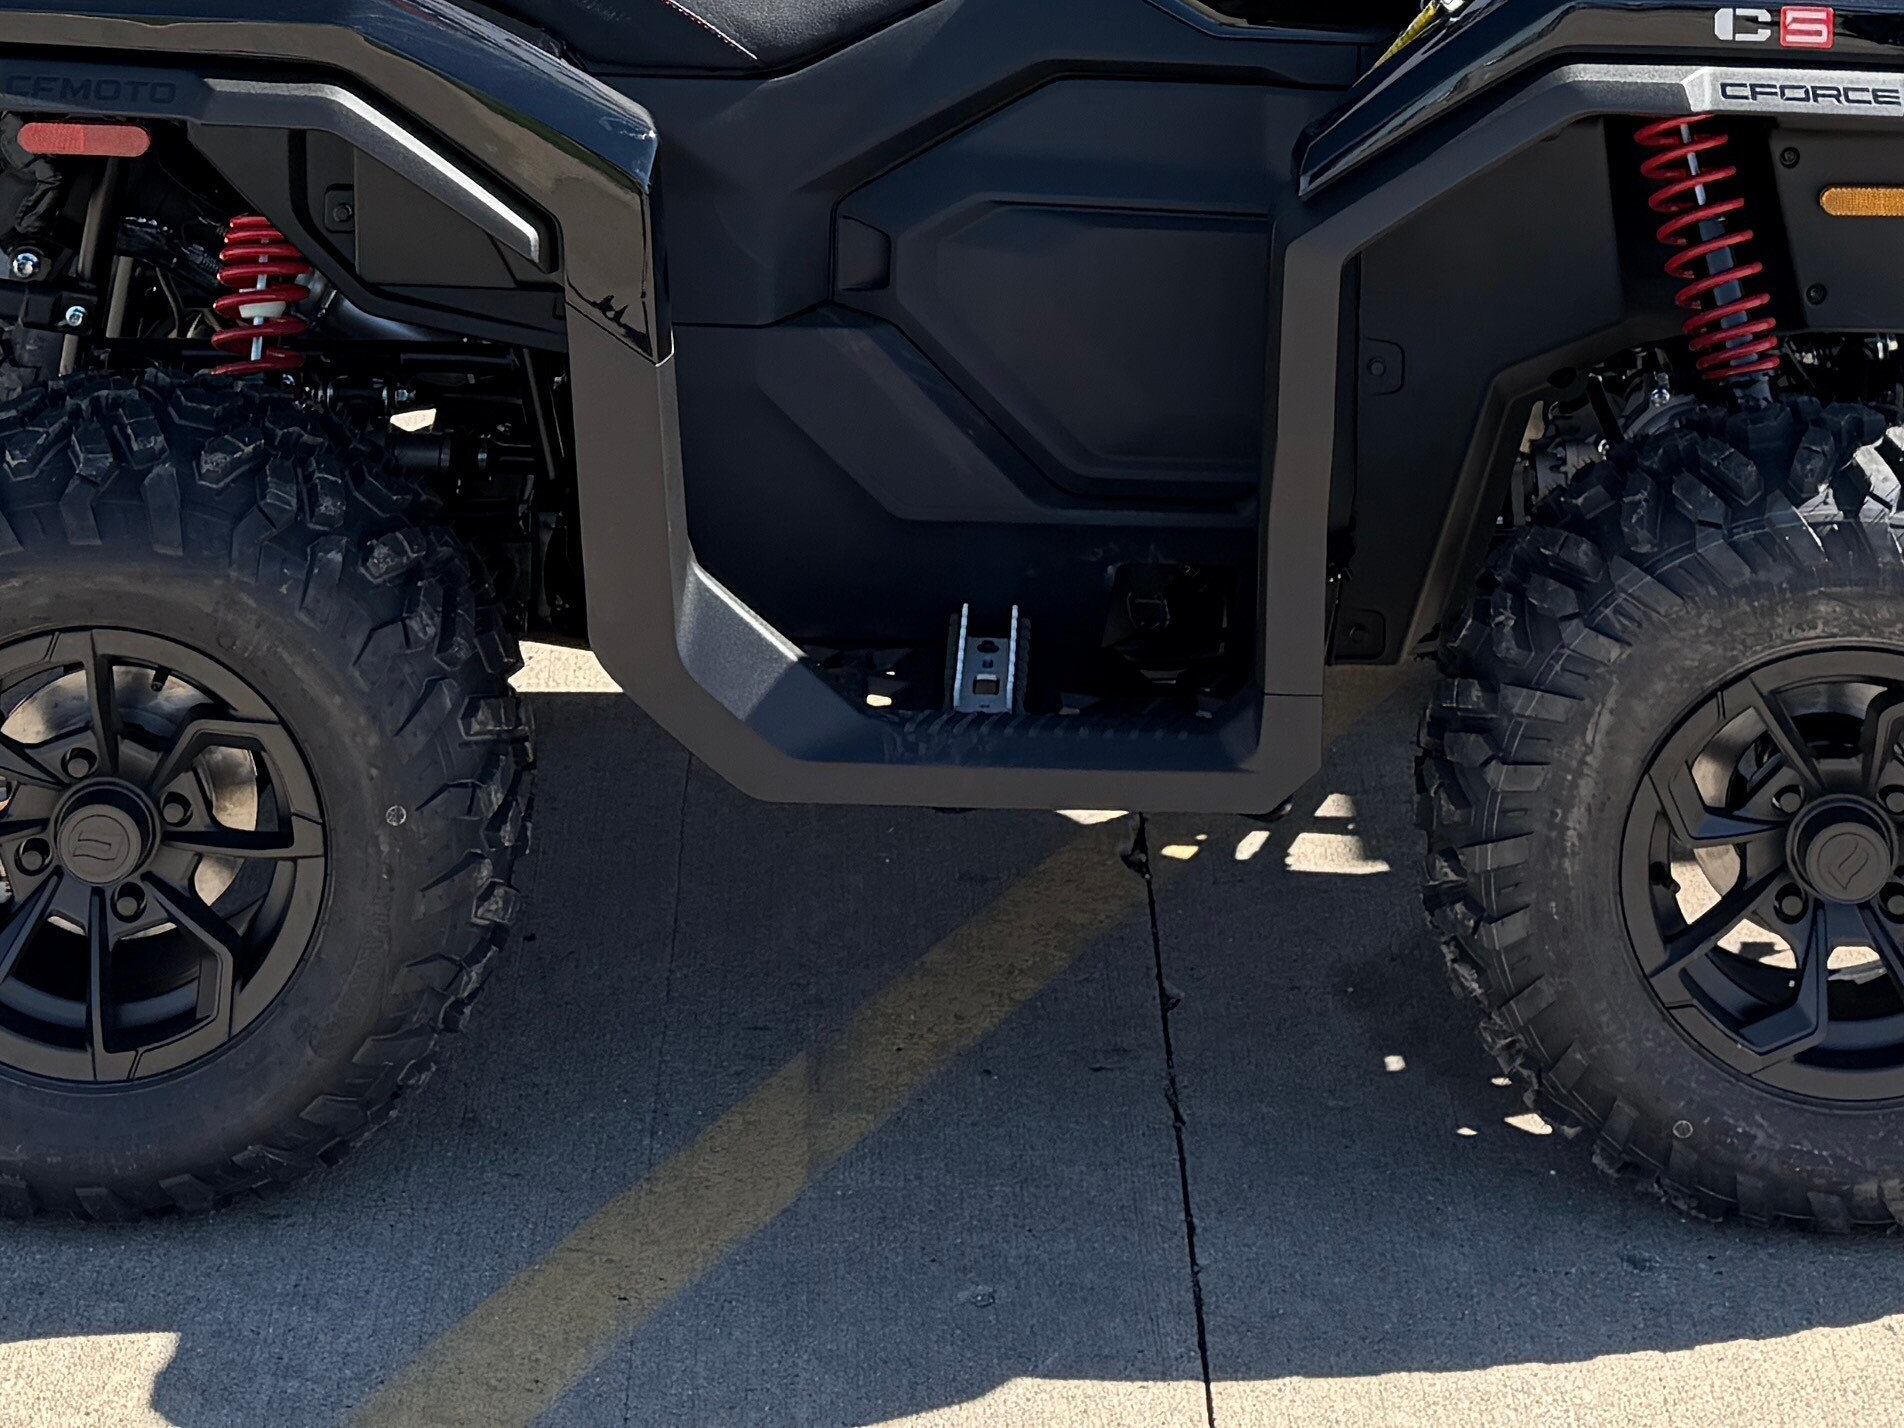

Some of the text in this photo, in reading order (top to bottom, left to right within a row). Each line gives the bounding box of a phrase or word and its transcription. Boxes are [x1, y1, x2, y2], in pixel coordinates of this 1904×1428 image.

[1714, 6, 1834, 49] C5
[6, 74, 178, 105] CFMOTO
[1719, 82, 1902, 107] CFORCE
